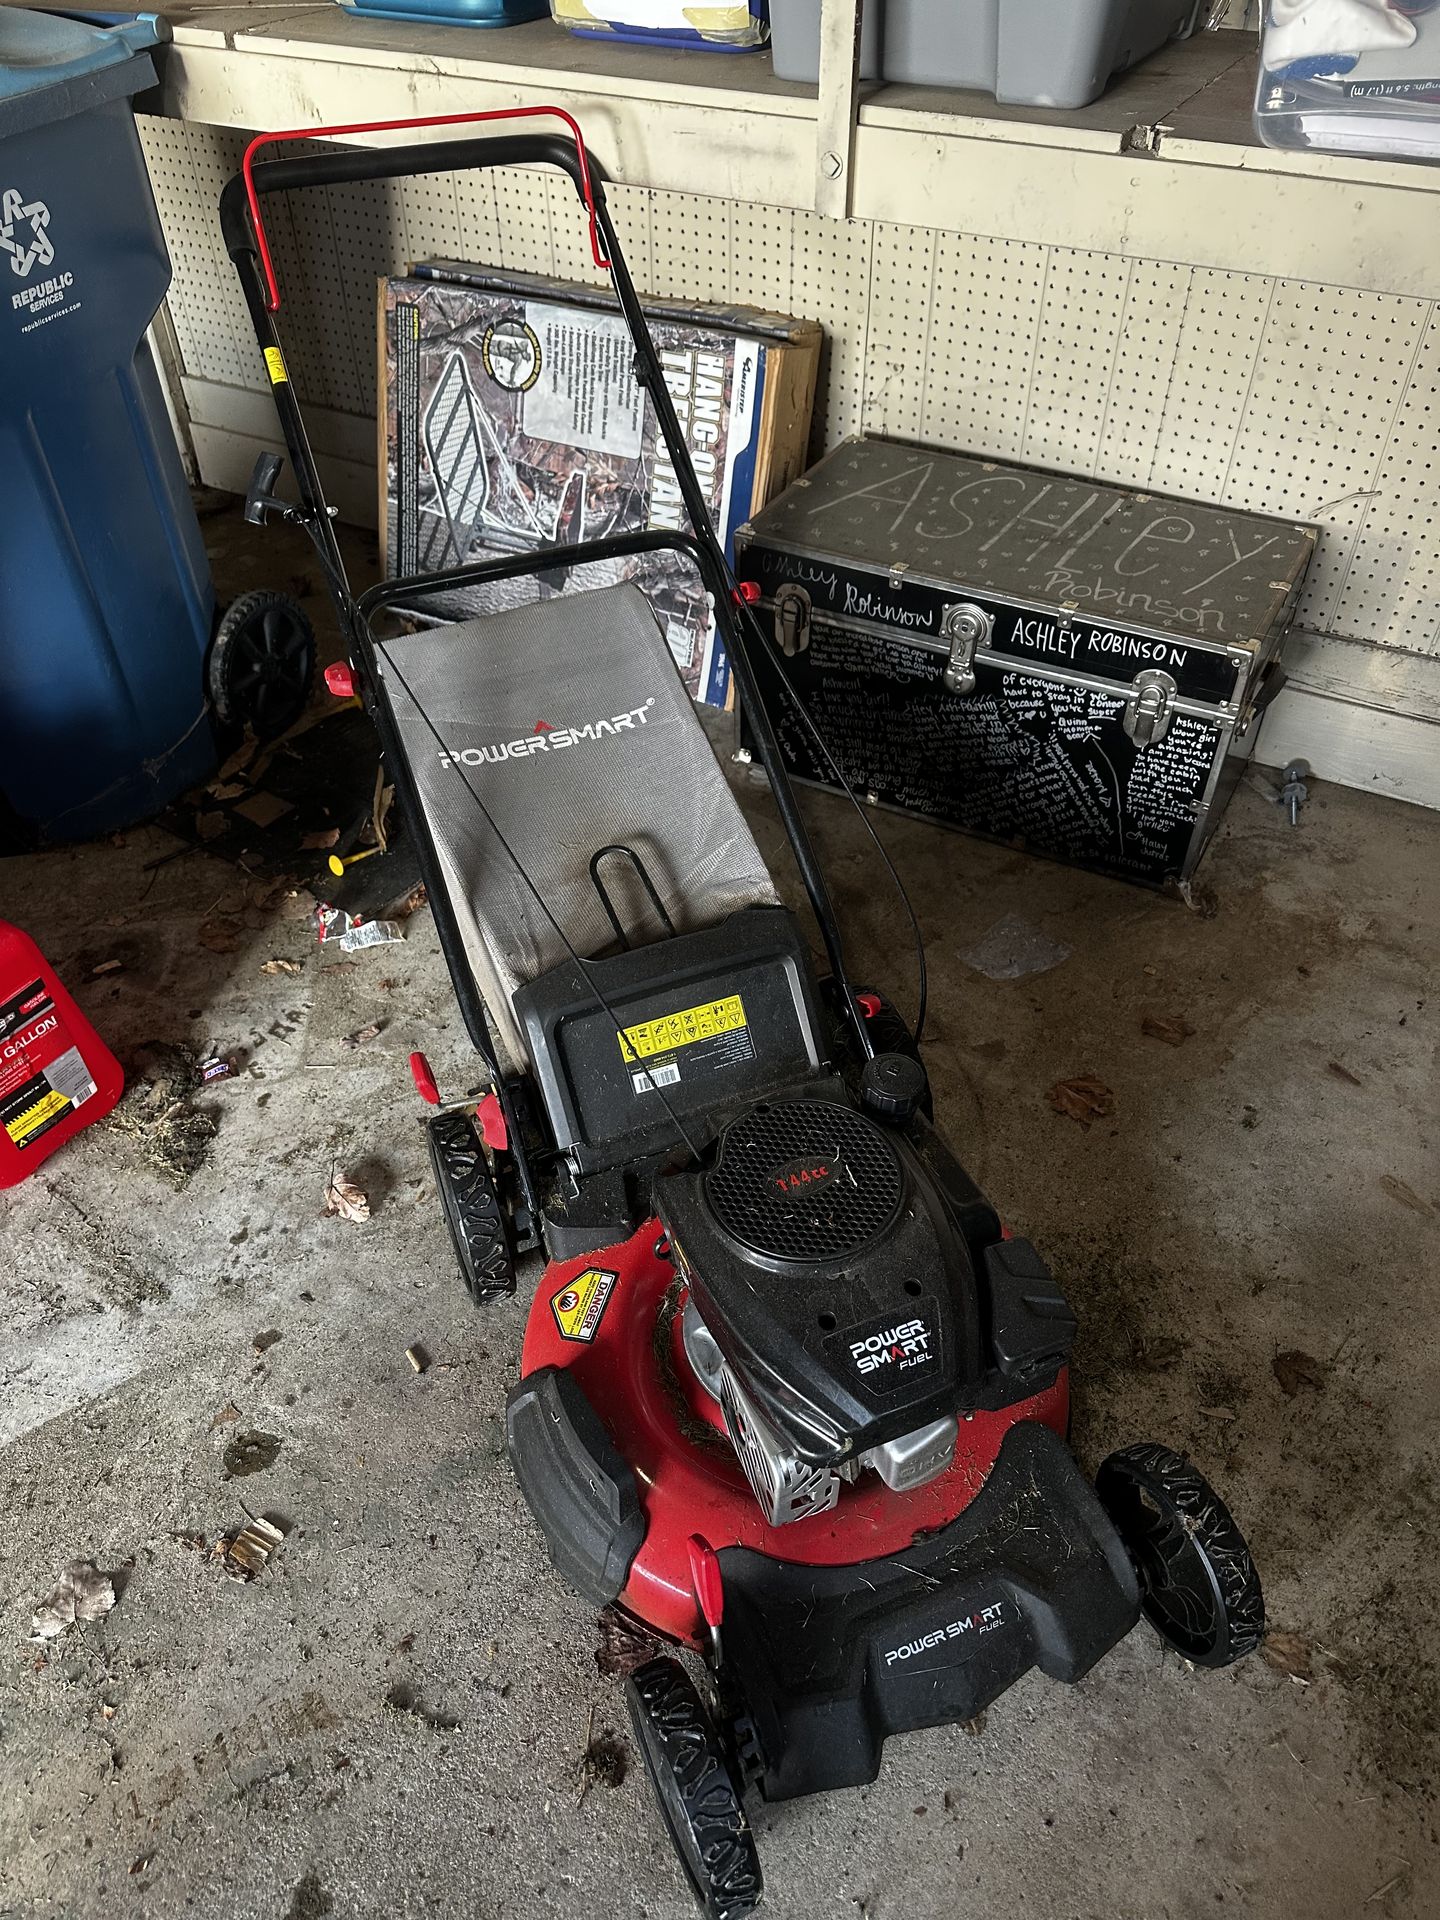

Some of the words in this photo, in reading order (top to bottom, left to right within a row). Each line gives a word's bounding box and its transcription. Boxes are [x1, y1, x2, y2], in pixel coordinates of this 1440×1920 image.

[12, 272, 73, 309] REPUBLIC
[29, 291, 64, 313] SERVICES
[21, 302, 82, 333] republicservices.com
[843, 582, 933, 627] Robinson
[1044, 571, 1226, 632] Robinson
[1011, 617, 1081, 659] ASHLEY
[1087, 630, 1188, 667] ROBINSON
[1003, 688, 1027, 696] have
[1048, 694, 1071, 702] stay
[1008, 700, 1044, 708] because
[1051, 704, 1083, 717] you're
[1088, 708, 1116, 717] super
[1199, 734, 1216, 742] girl
[1158, 744, 1213, 760] amazing!
[1133, 768, 1157, 777] with
[1147, 756, 1169, 765] have
[1171, 762, 1197, 773] been
[1149, 764, 1165, 772] the
[1170, 770, 1200, 781] cabin
[1127, 781, 1148, 791] fun
[1151, 788, 1173, 800] this
[1130, 774, 1150, 782] had
[1167, 785, 1193, 794] much
[1128, 790, 1156, 799] week
[1127, 797, 1157, 807] gonna
[1160, 805, 1184, 814] miss
[1127, 804, 1145, 813] you
[1160, 819, 1175, 827] you
[4, 1015, 57, 1057] GALLON
[776, 1165, 828, 1192] 144cc
[582, 1282, 609, 1330] DANGER
[849, 1319, 926, 1359] POWER
[856, 1333, 931, 1374] SMART
[899, 1353, 932, 1370] FUEL
[980, 1619, 1005, 1635] FUEL
